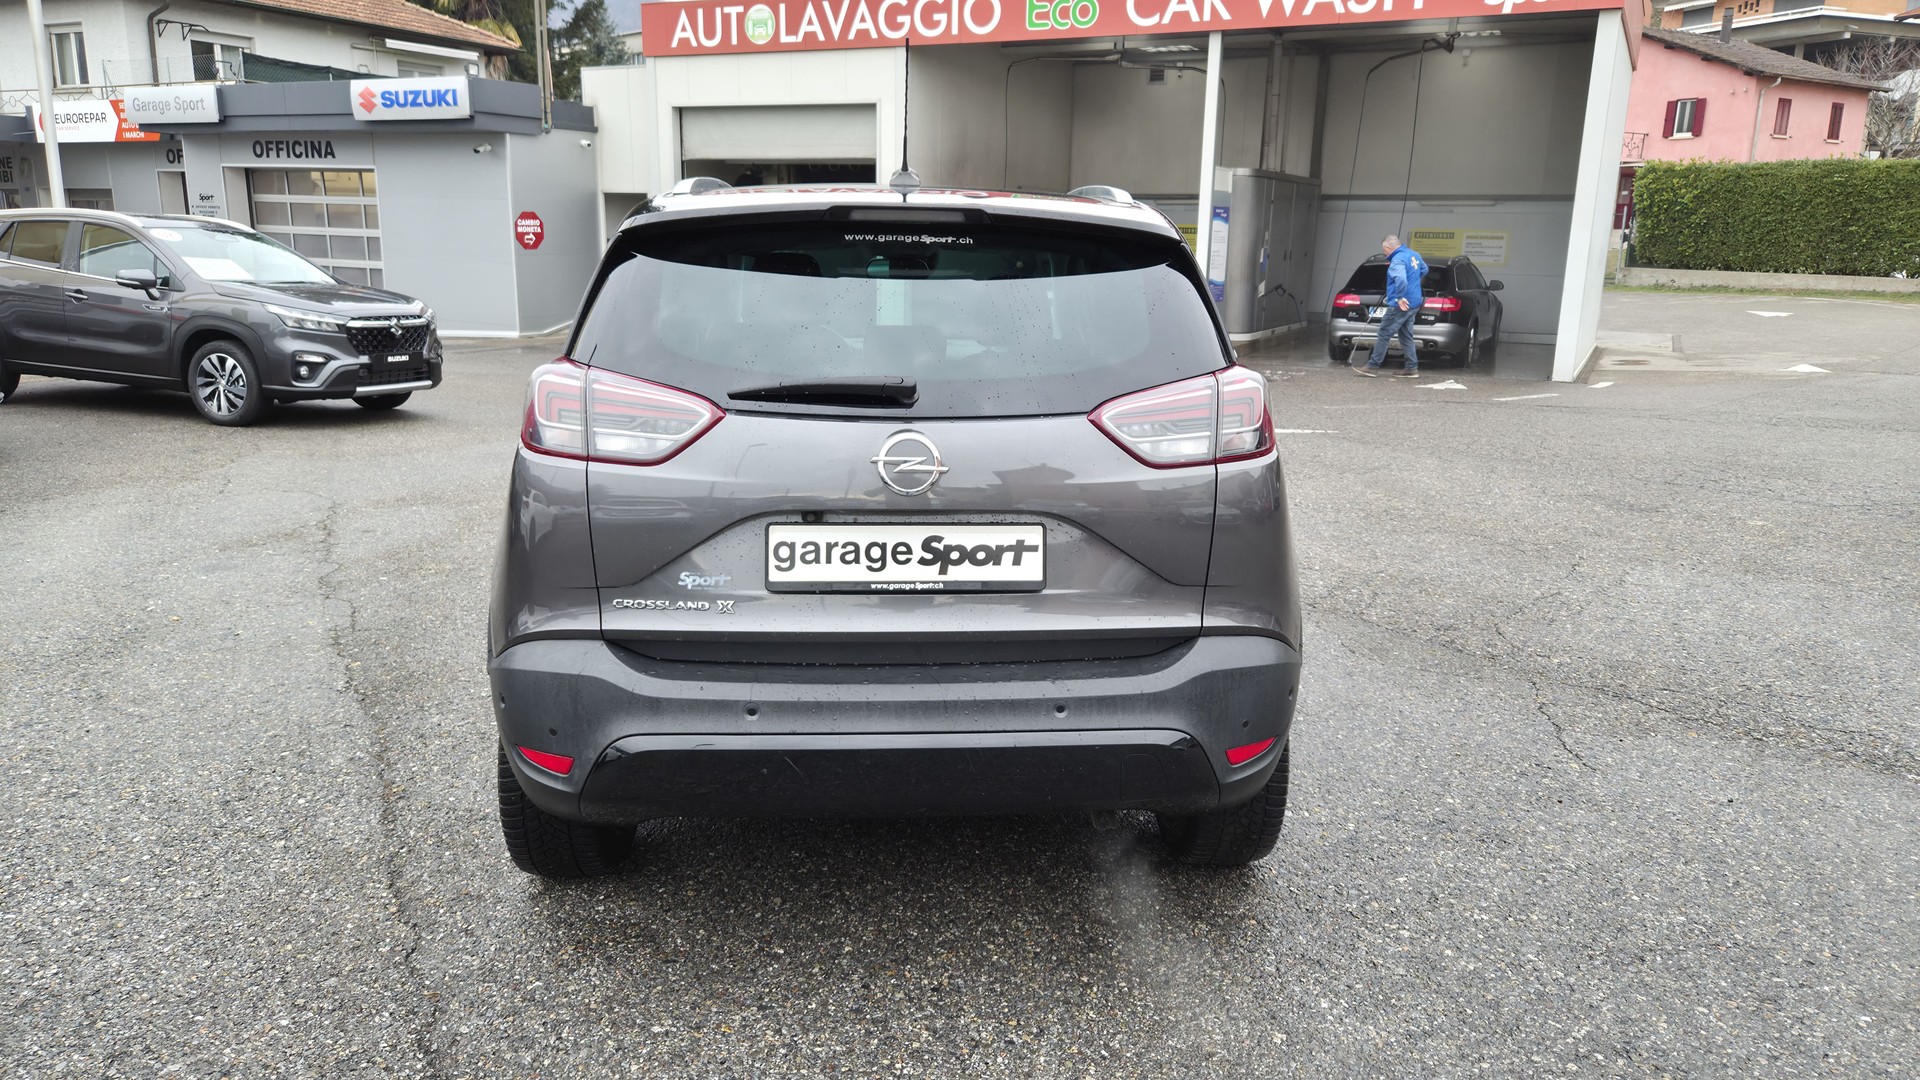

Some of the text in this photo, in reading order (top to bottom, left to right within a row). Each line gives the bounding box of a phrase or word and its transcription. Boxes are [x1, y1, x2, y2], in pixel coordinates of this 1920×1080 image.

[132, 97, 206, 116] Garage Sport
[380, 88, 459, 108] SUZUKI
[54, 111, 107, 124] EUROREPAR
[252, 140, 336, 159] OFFICINA
[678, 571, 731, 589] Sport
[612, 599, 735, 614] CROSSLAND X
